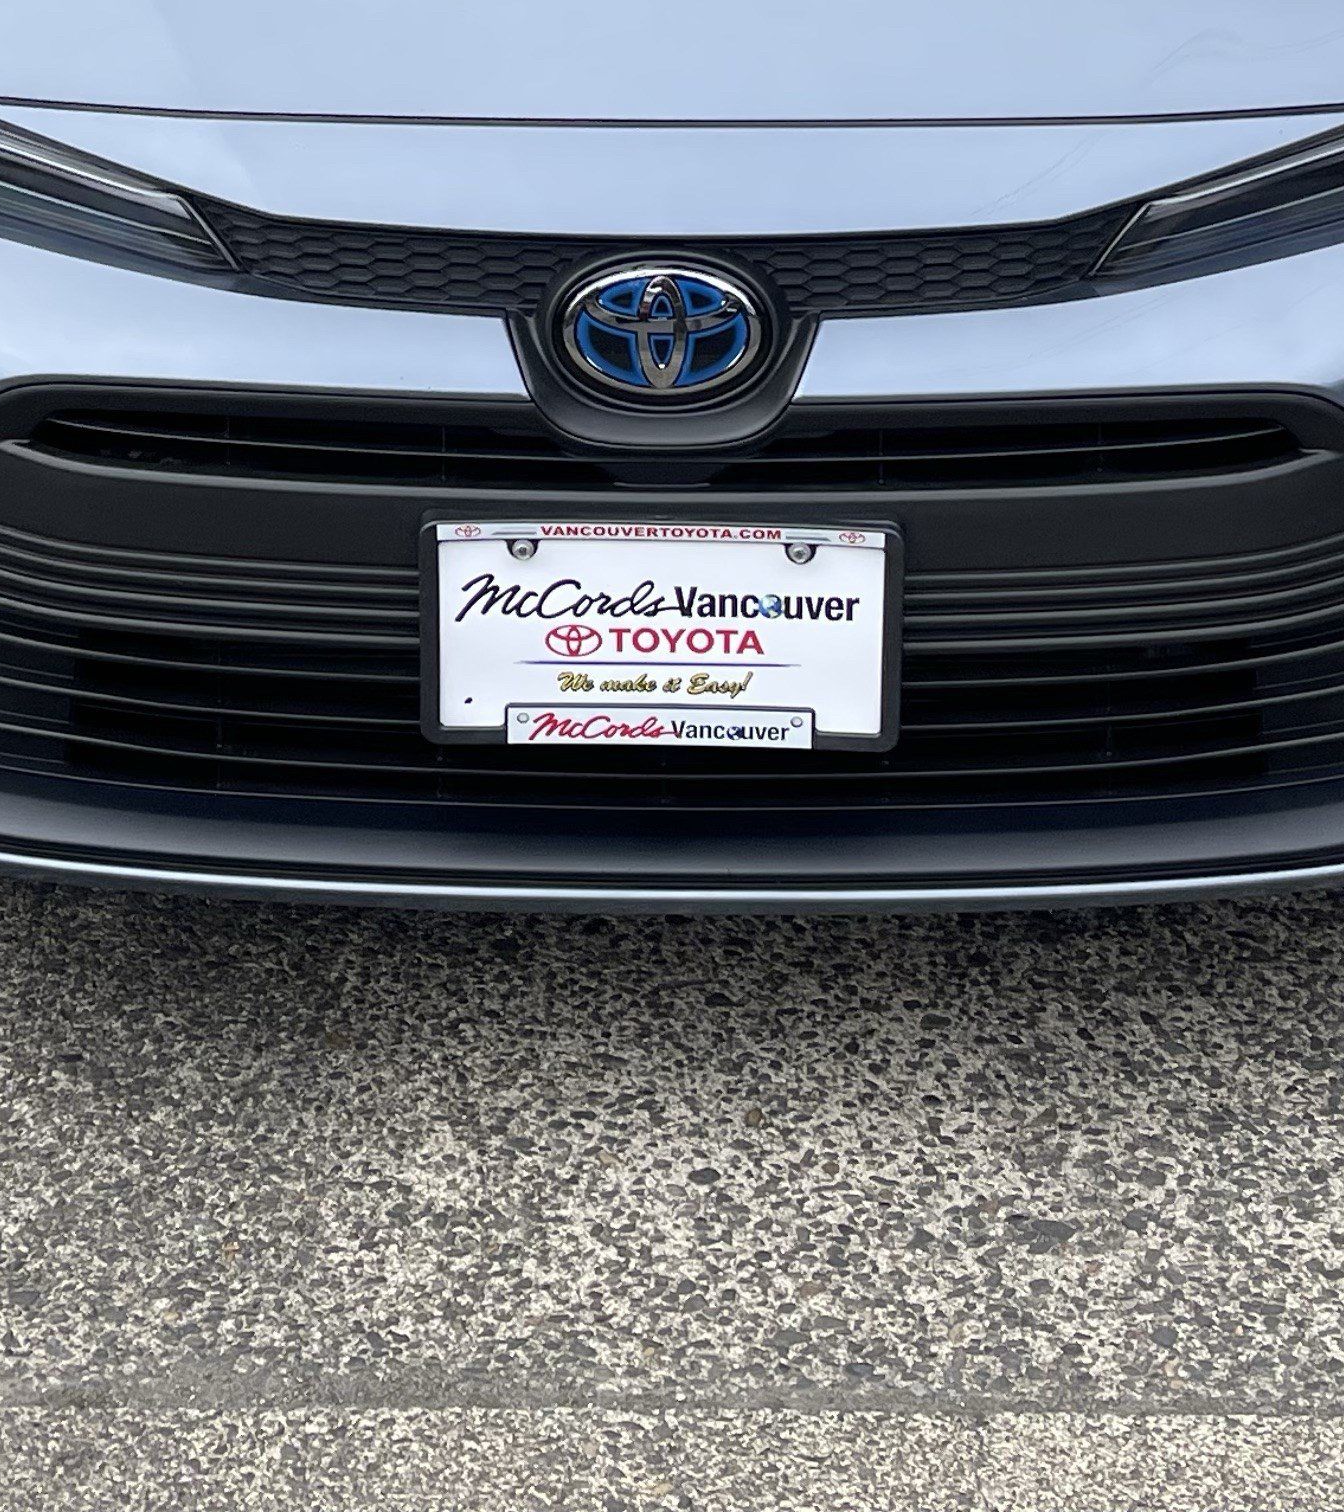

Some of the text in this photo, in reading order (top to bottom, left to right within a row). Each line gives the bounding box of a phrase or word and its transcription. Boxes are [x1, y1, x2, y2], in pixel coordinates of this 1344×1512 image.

[540, 525, 782, 540] VANCOUVERTOYOTA.COM
[609, 627, 765, 655] TOYOTA
[558, 671, 754, 699] We make it Easy!
